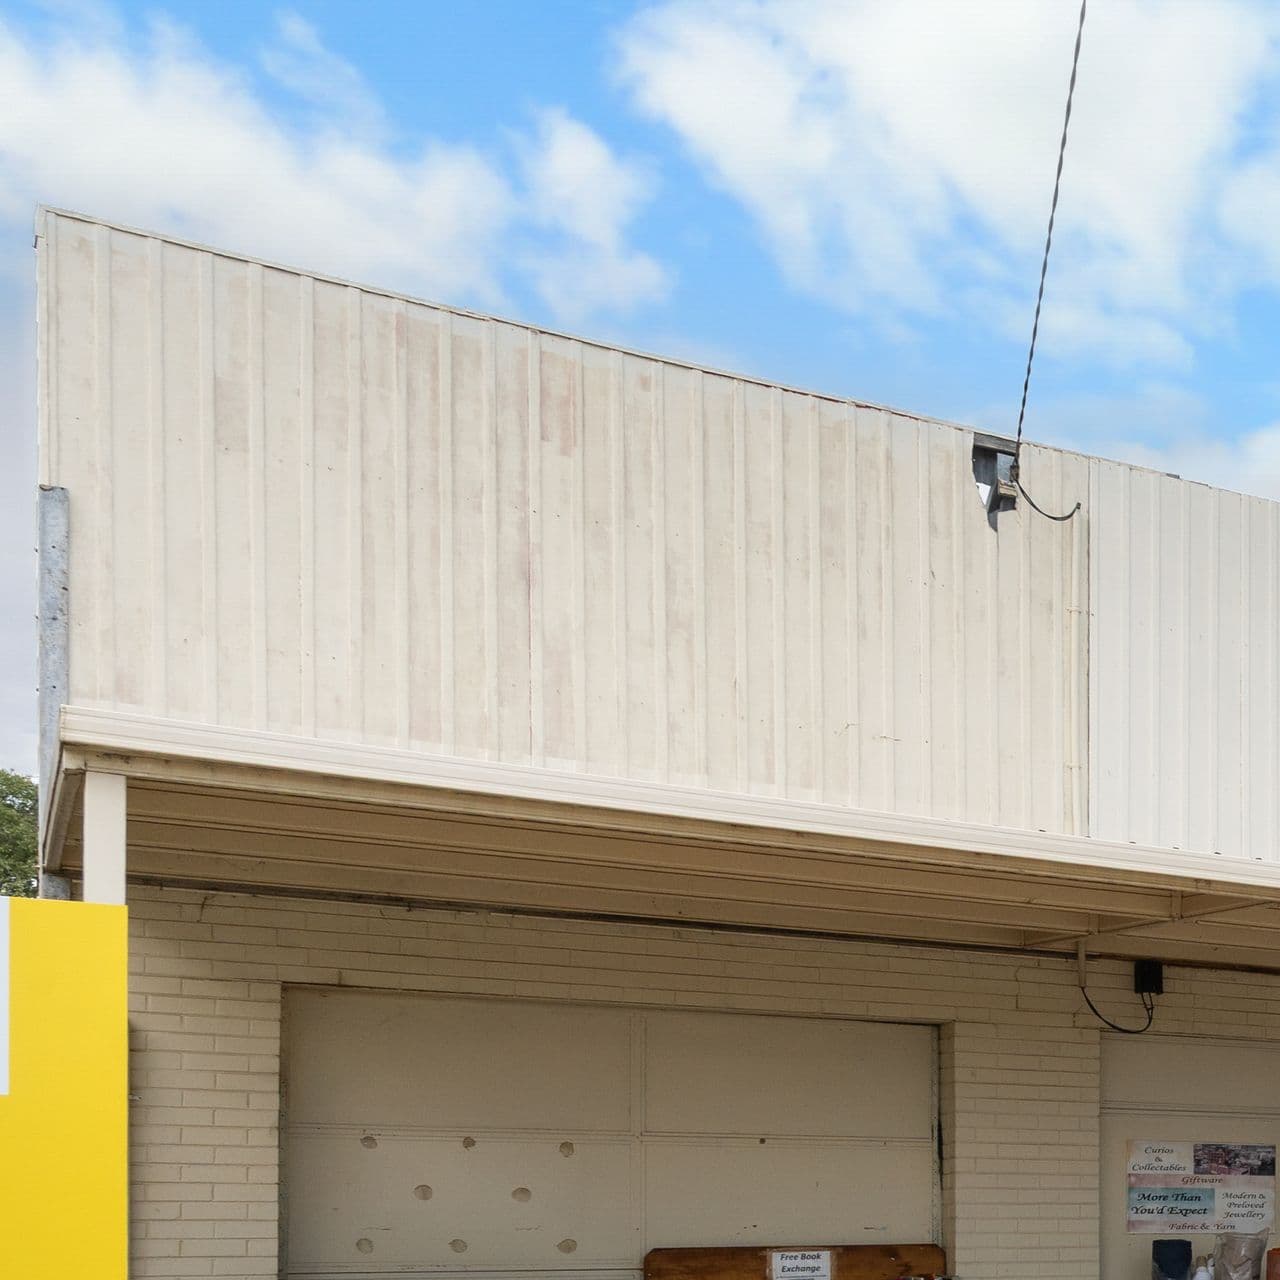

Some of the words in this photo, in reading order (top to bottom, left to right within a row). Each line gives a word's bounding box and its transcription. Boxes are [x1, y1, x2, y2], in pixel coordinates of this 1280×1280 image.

[1144, 1146, 1174, 1154] Curios
[1132, 1163, 1187, 1172] Collectables
[1182, 1176, 1223, 1185] Giftware
[1137, 1192, 1168, 1202] More
[1171, 1192, 1202, 1202] Than
[1222, 1192, 1257, 1200] Modern
[1227, 1201, 1265, 1209] Preloved
[1131, 1206, 1164, 1215] You'd
[1167, 1206, 1208, 1217] Expect
[1224, 1211, 1265, 1220] Jewellery
[780, 1253, 799, 1261] Free
[800, 1252, 822, 1260] Book
[781, 1265, 821, 1273] Exchange
